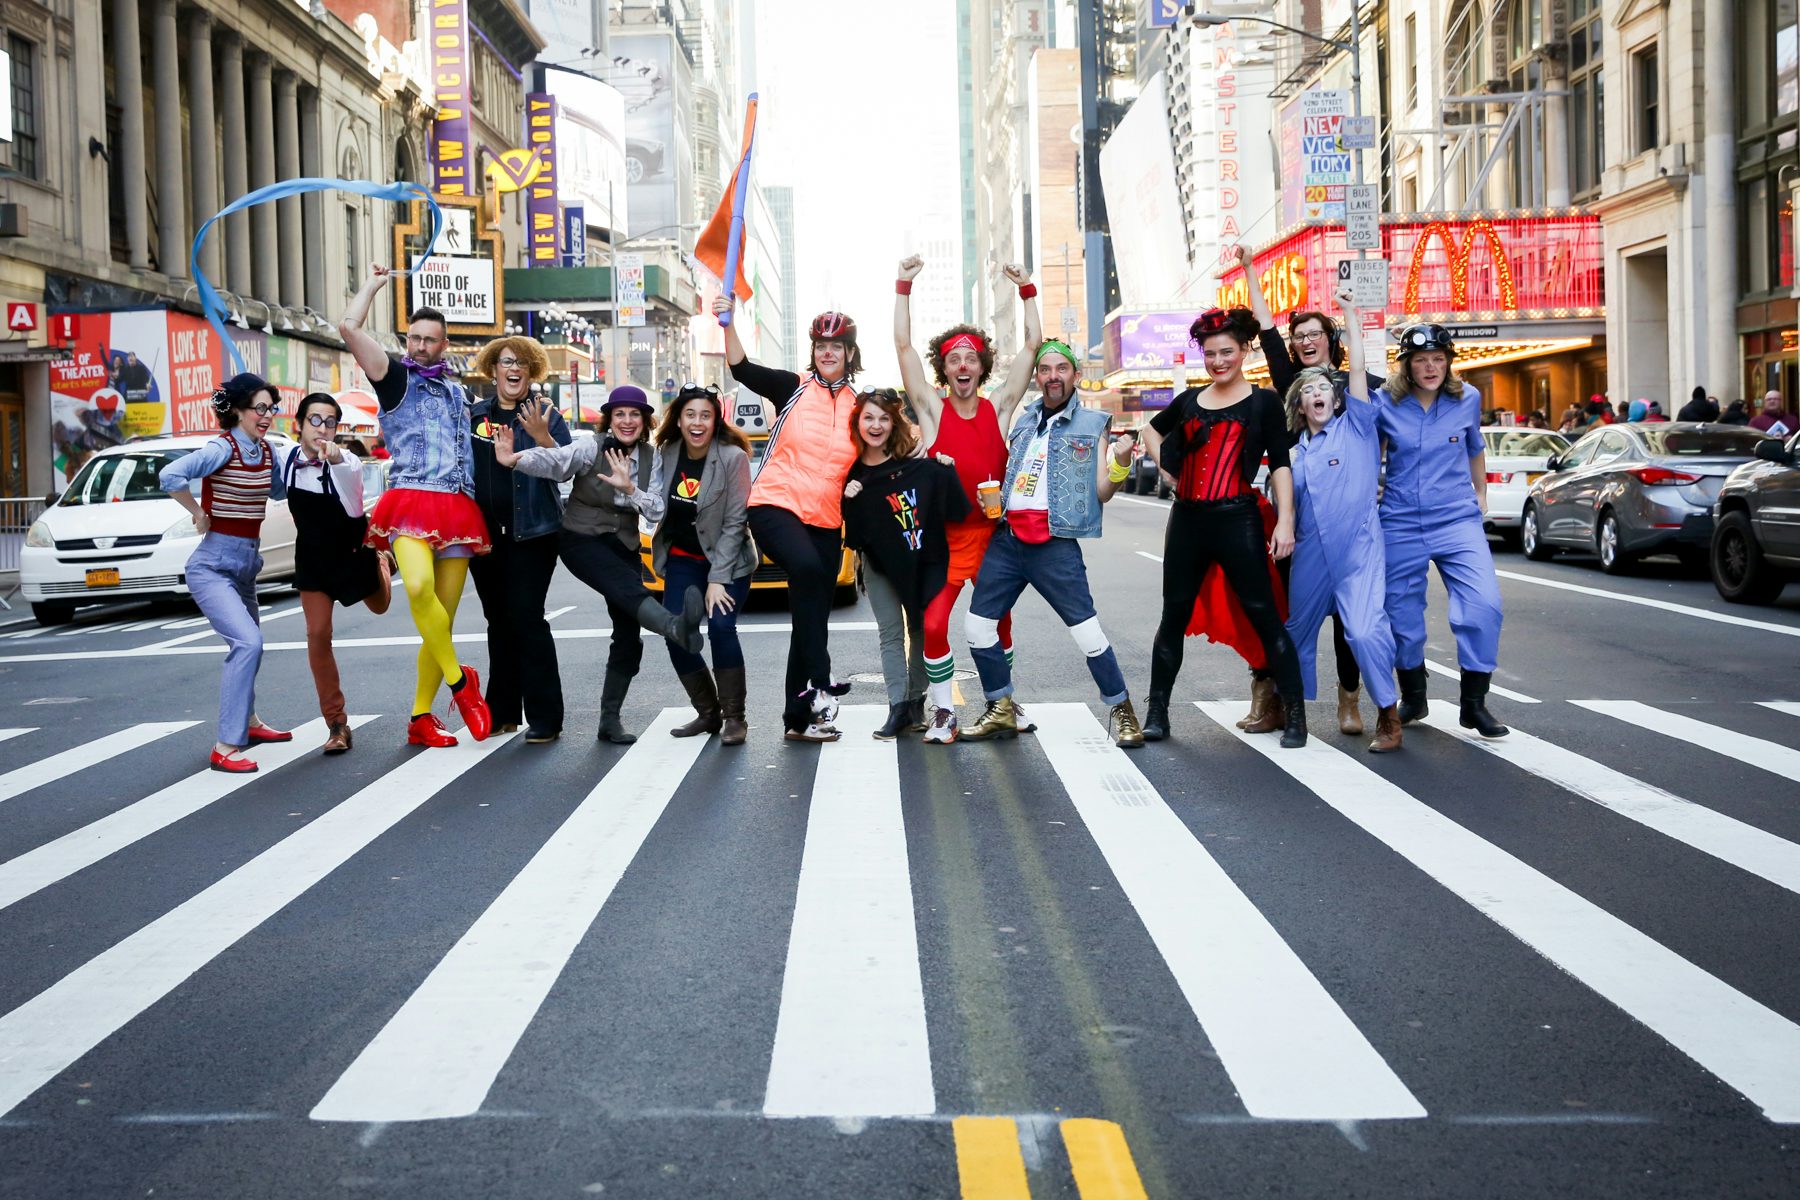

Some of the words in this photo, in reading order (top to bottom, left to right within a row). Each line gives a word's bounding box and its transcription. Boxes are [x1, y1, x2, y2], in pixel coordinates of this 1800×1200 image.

[1305, 115, 1343, 135] NEW
[1304, 137, 1334, 154] VIC
[1312, 155, 1349, 172] TORY
[1305, 187, 1327, 203] 20
[1353, 188, 1370, 198] BUS
[1351, 200, 1373, 209] LANE
[532, 213, 555, 259] NEW
[1354, 263, 1384, 271] BUSES
[420, 274, 450, 290] LORD
[455, 276, 468, 290] OF
[1357, 276, 1380, 284] ONLY
[421, 292, 442, 307] THE
[10, 306, 33, 327] A
[1063, 318, 1076, 326] 25
[172, 330, 195, 363] LOVE
[197, 329, 208, 360] OF
[78, 352, 91, 366] OF
[59, 365, 105, 380] THEATER
[81, 379, 101, 387] here
[175, 364, 213, 399] THEATER
[178, 398, 216, 432] STARTS
[885, 488, 917, 512] NEW
